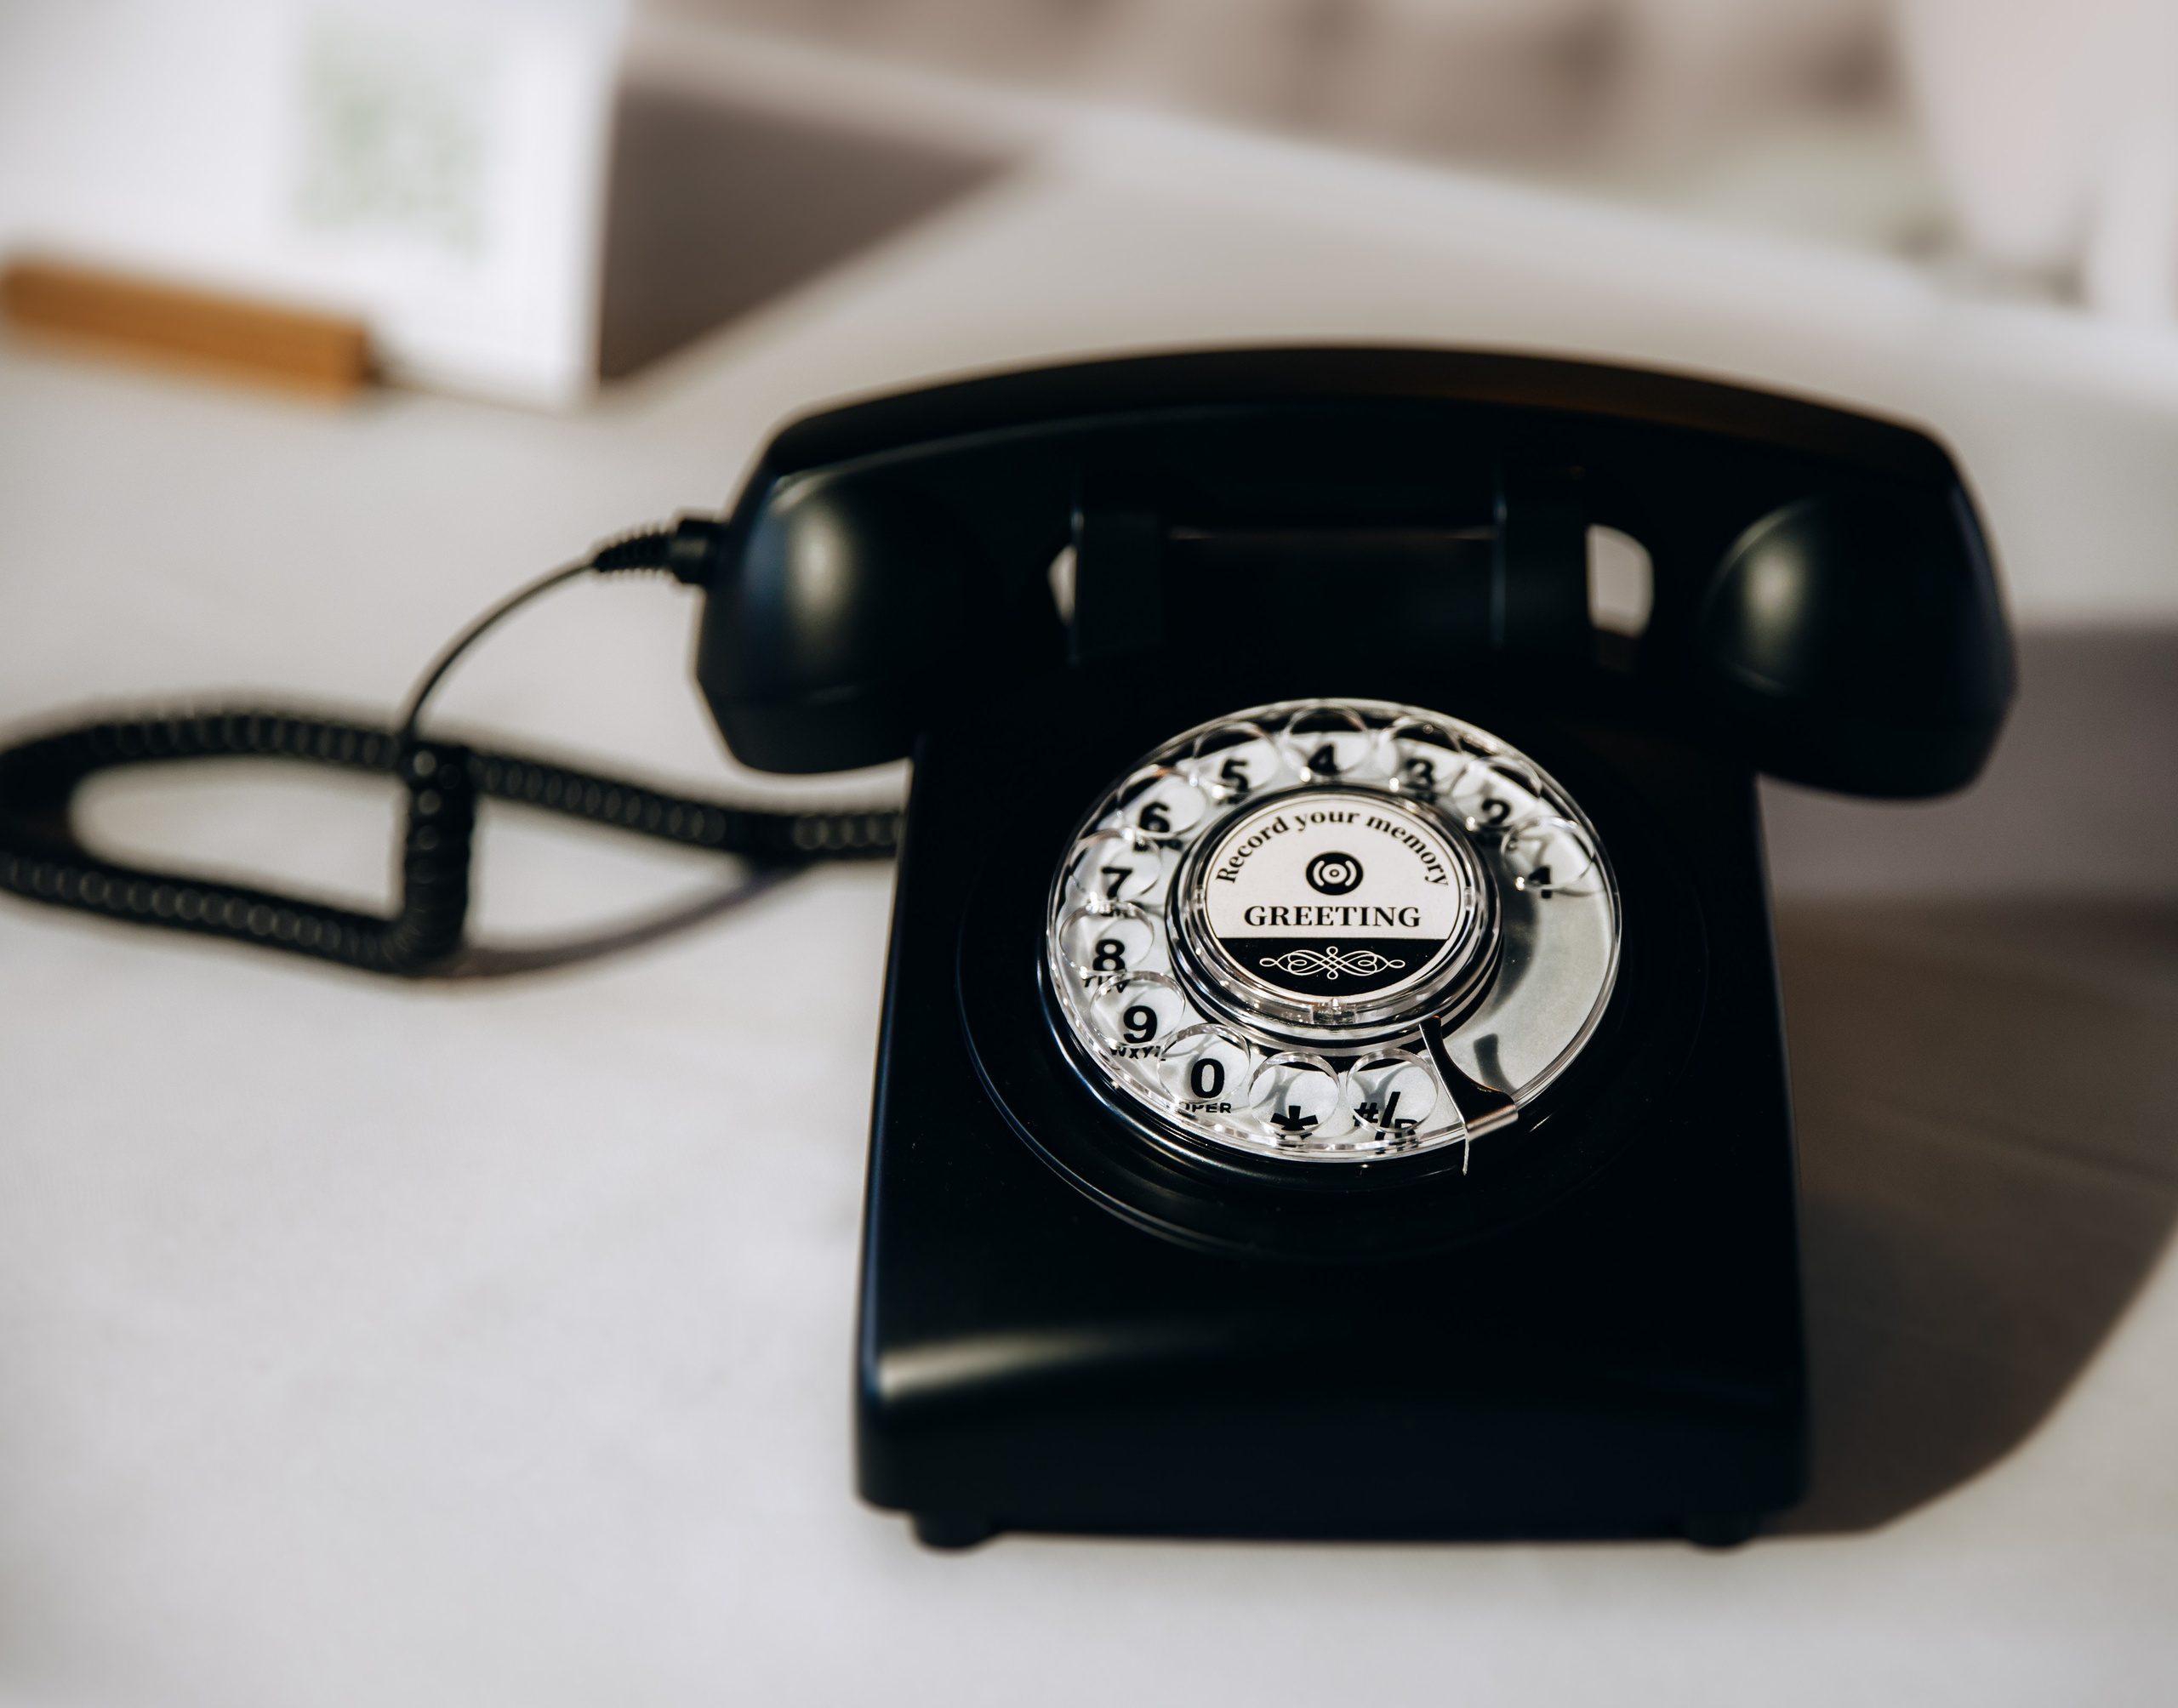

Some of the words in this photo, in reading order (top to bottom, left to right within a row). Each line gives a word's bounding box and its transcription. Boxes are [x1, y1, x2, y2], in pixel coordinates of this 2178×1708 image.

[1220, 759, 1250, 793] 5
[1308, 743, 1340, 776] 4
[1405, 758, 1435, 790] 3
[1138, 800, 1171, 834] 6
[1481, 798, 1512, 829] 2
[1215, 817, 1291, 884] Record
[1294, 811, 1360, 832] your
[1365, 816, 1449, 887] memory
[1101, 866, 1133, 901] 7
[1243, 905, 1422, 927] GREETING
[1092, 938, 1126, 973] 8
[1123, 1005, 1158, 1044] 9
[1190, 1058, 1225, 1099] 0
